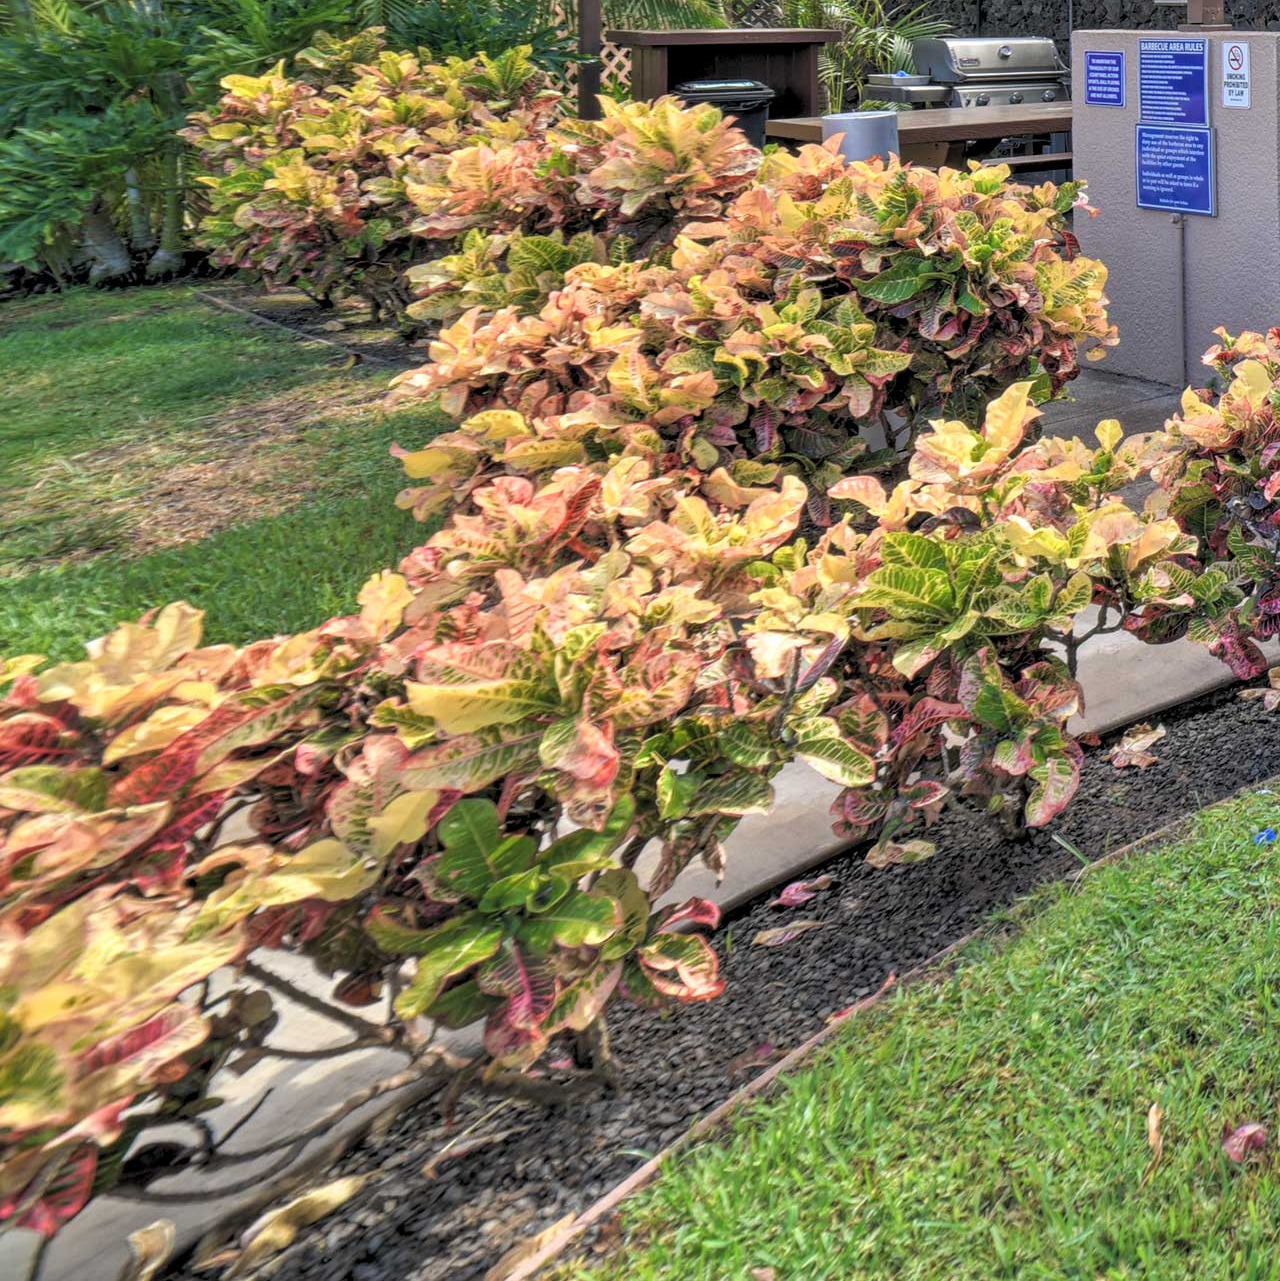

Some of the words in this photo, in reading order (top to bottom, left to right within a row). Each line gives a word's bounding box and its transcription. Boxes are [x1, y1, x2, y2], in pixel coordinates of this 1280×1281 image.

[1141, 42, 1168, 51] BARBECUE
[1169, 43, 1184, 51] AREA
[1185, 43, 1203, 52] RULES
